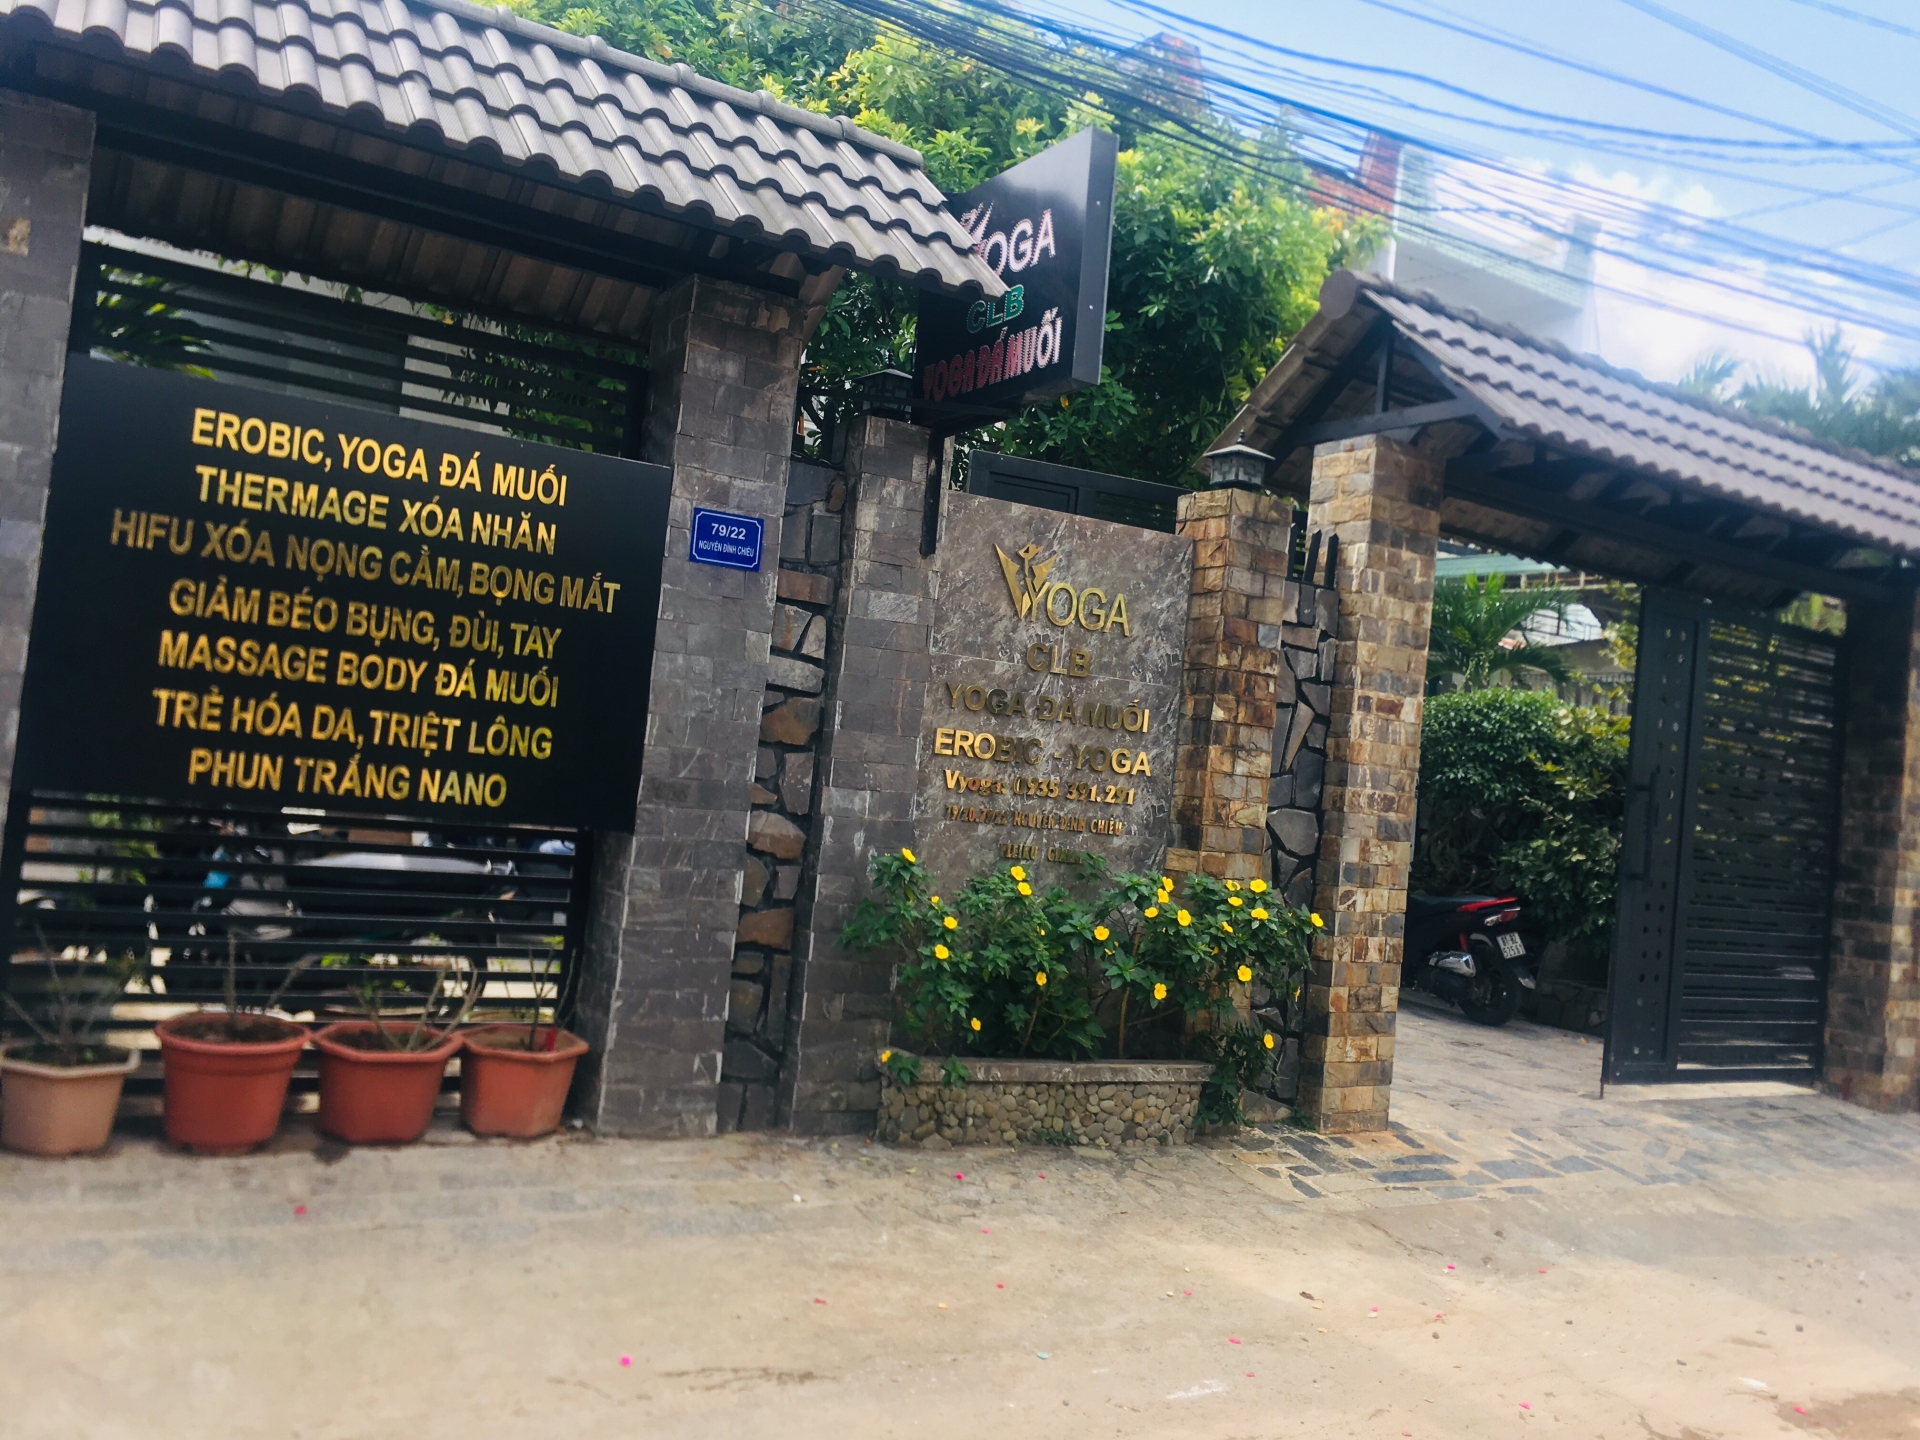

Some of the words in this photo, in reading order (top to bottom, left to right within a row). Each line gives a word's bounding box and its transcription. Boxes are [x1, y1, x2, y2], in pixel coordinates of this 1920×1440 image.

[923, 350, 976, 402] YOGA
[1003, 307, 1062, 380] MUỐI
[191, 407, 332, 473] EROBIC,
[337, 433, 429, 484] YOGA
[439, 451, 482, 493] ĐÁ
[492, 464, 568, 507] MUỐI
[195, 464, 390, 530] THERMAGE
[398, 495, 464, 542] XÓA
[470, 511, 557, 556] NHĂN
[711, 523, 746, 540] 79/22
[110, 508, 194, 555] HIFU
[201, 518, 276, 567] XÓA
[285, 534, 383, 582] NỌNG
[469, 561, 556, 606] BỌNG
[559, 572, 621, 613] MẮT
[169, 574, 261, 625] GIẢM
[266, 586, 339, 633] BÉO
[346, 601, 440, 652] BỤNG,
[449, 610, 505, 659] ĐÙI,
[510, 622, 562, 659] TAY
[157, 629, 329, 684] MASSAGE
[336, 650, 428, 694] BODY
[435, 658, 477, 699] ĐÁ
[485, 665, 559, 708] MUỐI
[1027, 642, 1091, 678] CLB
[152, 684, 225, 732] TRẺ
[230, 691, 303, 739] HÓA
[311, 703, 364, 750] DA,
[369, 709, 462, 758] TRIỆT
[467, 714, 553, 760] LÔNG
[946, 681, 1028, 718] YOGA
[1036, 692, 1076, 725] ĐÁ
[1083, 699, 1150, 733] MUỐI
[188, 746, 284, 791] PHUN
[293, 752, 411, 801] TRẮNG
[418, 767, 508, 808] NANO
[934, 727, 1043, 765] EROBIC
[1070, 743, 1151, 777] YOGA
[1012, 776, 1060, 799] 0935
[1066, 781, 1136, 806] 391.291
